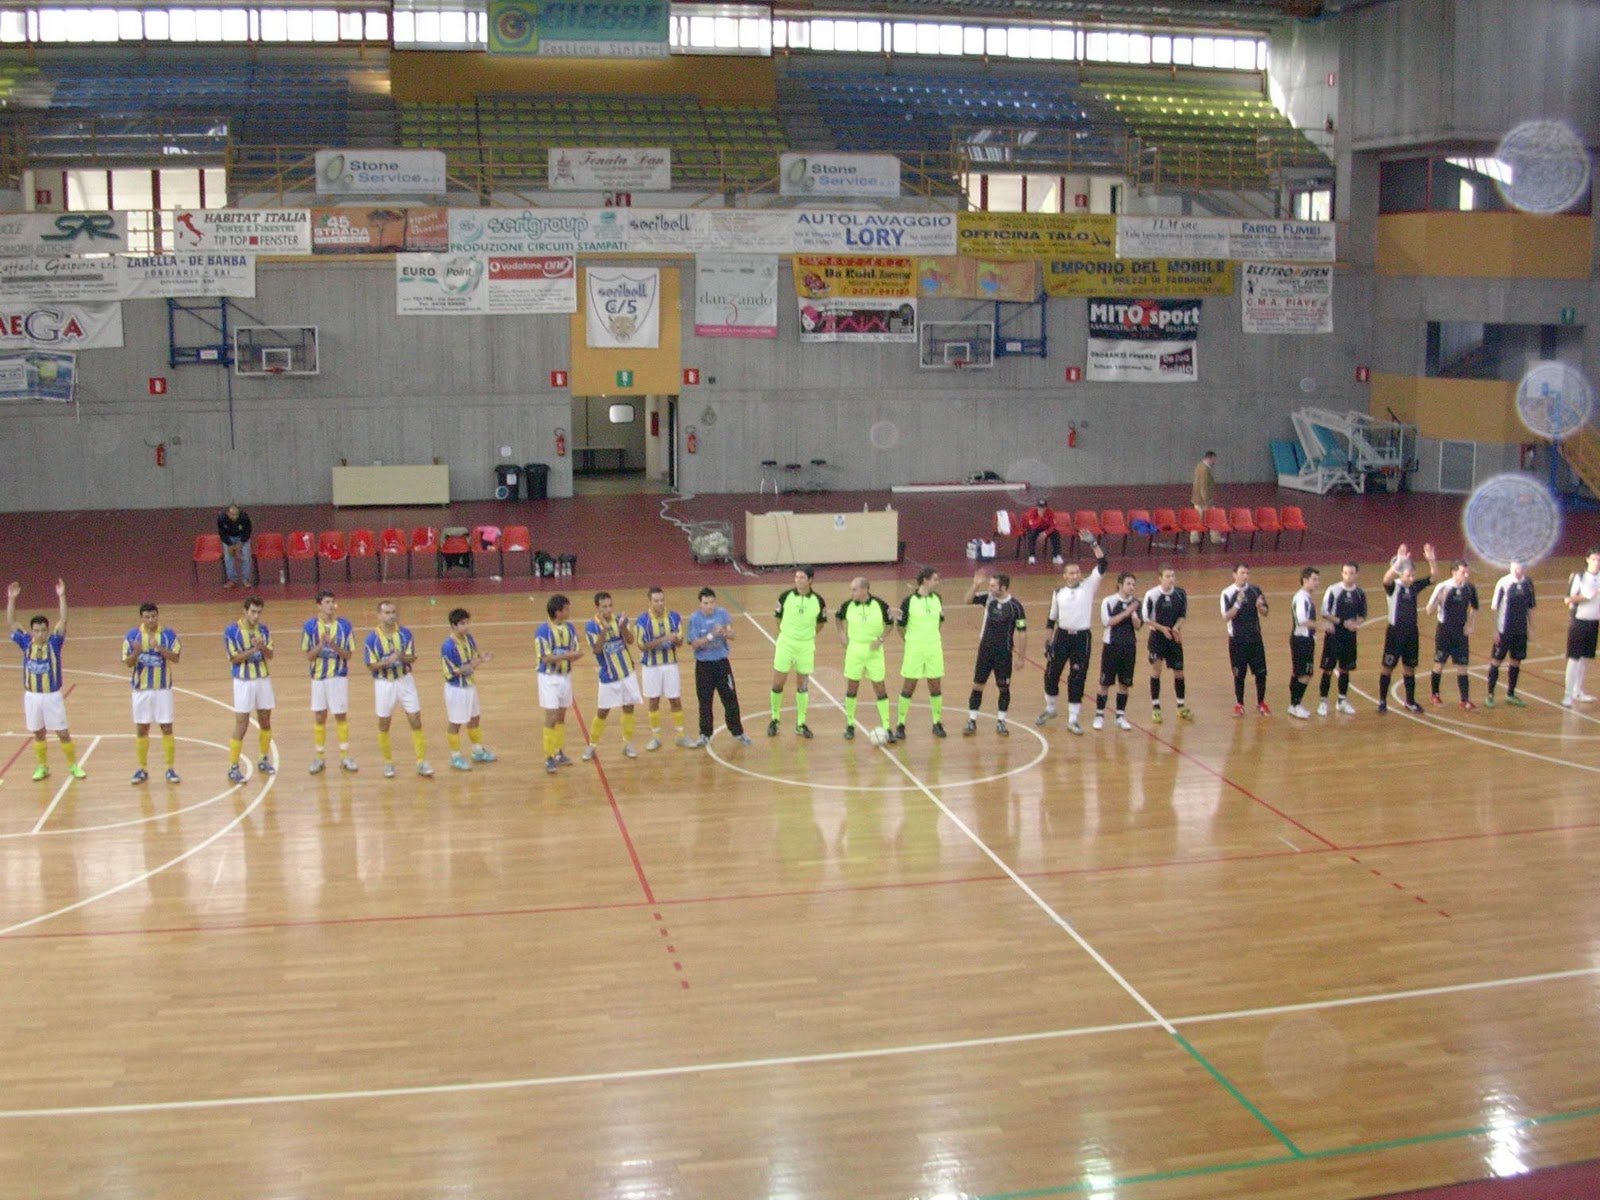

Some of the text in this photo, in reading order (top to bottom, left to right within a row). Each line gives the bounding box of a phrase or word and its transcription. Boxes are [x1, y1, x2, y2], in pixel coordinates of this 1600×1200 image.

[544, 42, 667, 57] Gestione Sinistri
[350, 162, 399, 171] Stone
[811, 164, 857, 174] Stone
[358, 172, 422, 183] Service
[819, 175, 879, 186] Service
[204, 212, 308, 223] HABITAT ITALIA
[327, 215, 350, 229] 45
[798, 213, 952, 227] AUTOLAVAGGIO
[255, 224, 296, 232] FINESTRE
[488, 210, 589, 241] serigroup
[1241, 222, 1321, 235] FABIO FUMEI
[214, 235, 299, 246] TIP TOP FENSTER
[846, 227, 905, 247] LORY
[961, 229, 1089, 241] OFFICINA TALO
[450, 241, 524, 252] PRODUZIONE
[528, 241, 574, 252] CIRCUITI
[577, 241, 627, 251] STAMPATI
[127, 256, 178, 268] ZANELLA
[189, 256, 204, 266] DE
[208, 256, 248, 266] BARBA
[501, 261, 541, 271] vodafone
[1050, 260, 1226, 274] EMPORIO DEL MOBILE
[402, 265, 472, 278] EURO Point
[1090, 303, 1200, 329] MITO sport
